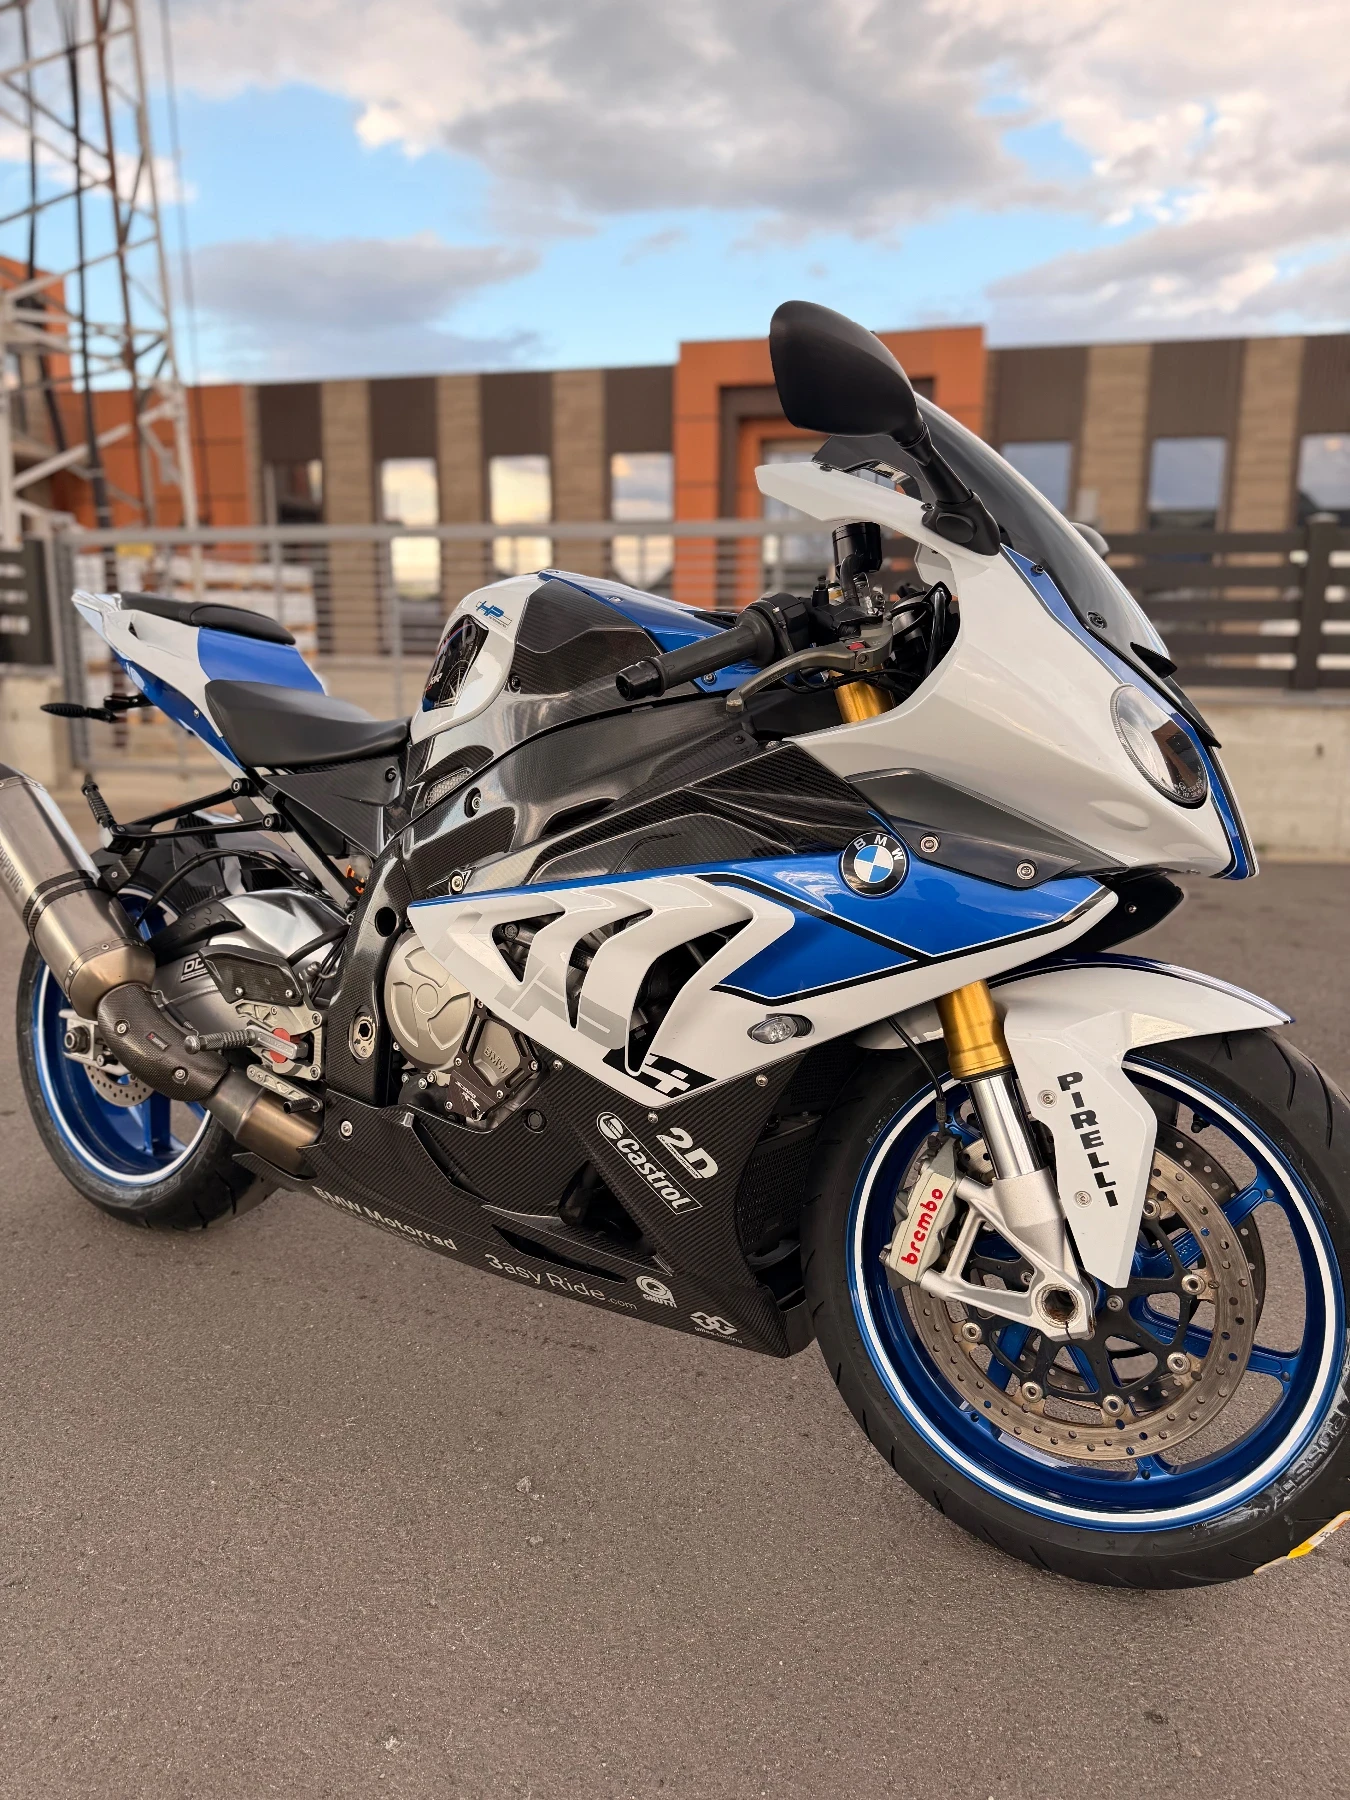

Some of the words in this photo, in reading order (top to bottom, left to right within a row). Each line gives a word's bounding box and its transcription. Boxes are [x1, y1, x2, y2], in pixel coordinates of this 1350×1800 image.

[476, 600, 505, 618] HP
[853, 834, 904, 861] BMW
[484, 1047, 508, 1074] BMW
[656, 1127, 719, 1179] 2D
[1057, 1071, 1119, 1207] PIRELLI
[616, 1138, 692, 1210] Castrol
[311, 1185, 362, 1214] BMW
[363, 1206, 458, 1251] Motorrad
[901, 1188, 944, 1265] brembo
[484, 1253, 541, 1285] 3asy
